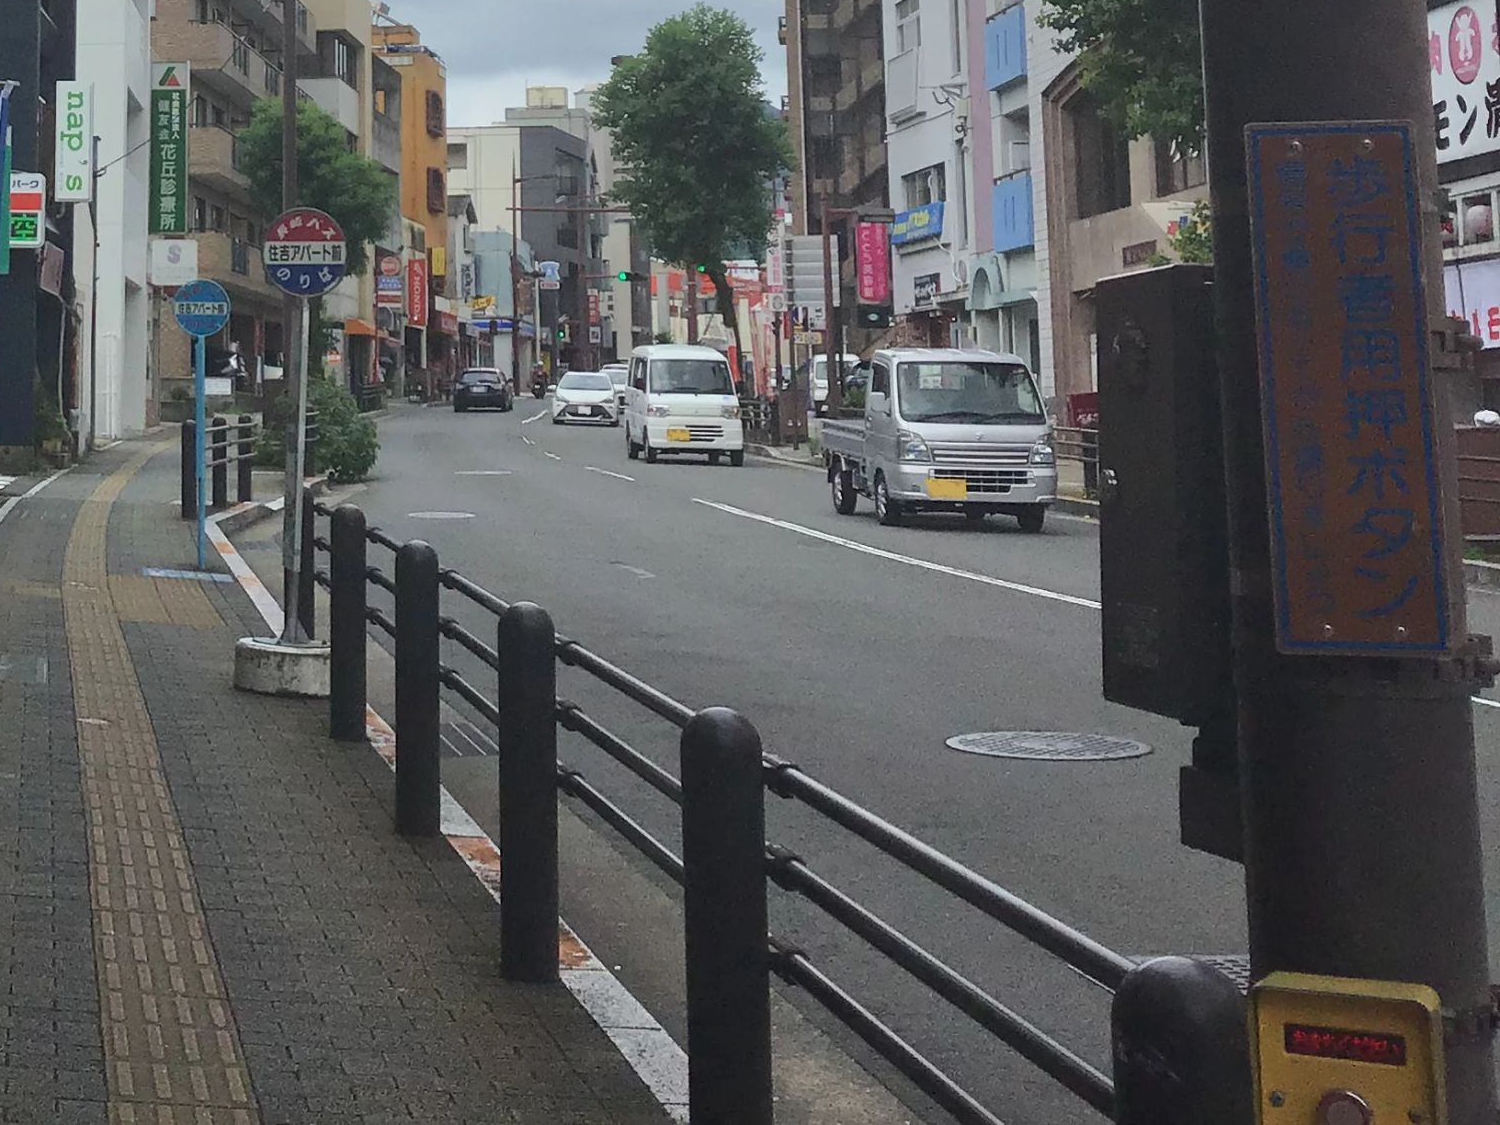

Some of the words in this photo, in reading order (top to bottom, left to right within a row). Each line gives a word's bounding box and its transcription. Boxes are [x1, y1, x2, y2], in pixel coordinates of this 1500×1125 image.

[60, 91, 88, 191] nap's
[160, 143, 177, 230] 花丘診療所
[10, 212, 36, 242] 空
[268, 245, 342, 262] 住吉アパート前
[276, 267, 333, 289] のりば
